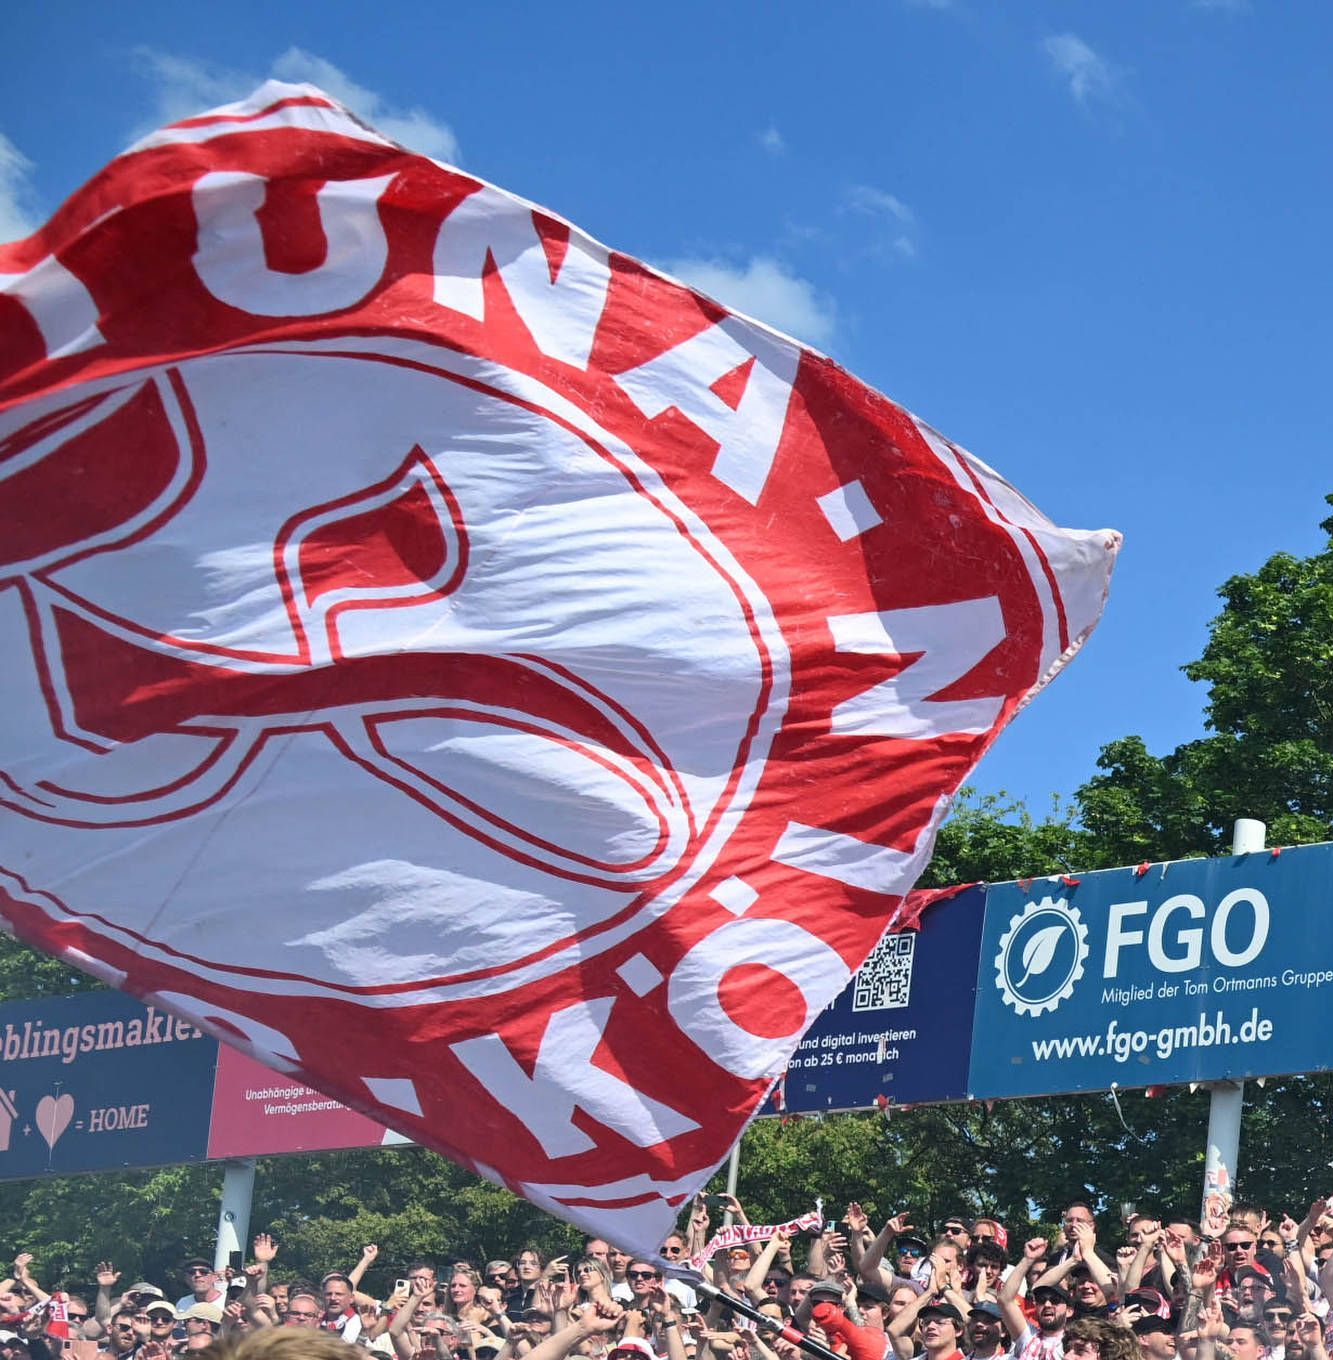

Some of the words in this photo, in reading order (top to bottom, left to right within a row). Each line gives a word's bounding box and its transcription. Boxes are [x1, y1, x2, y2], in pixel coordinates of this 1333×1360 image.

[1103, 887, 1271, 980] FGO
[1101, 982, 1153, 1007] Mitglied
[1157, 981, 1180, 999] der
[1184, 979, 1208, 996] Tom
[1213, 974, 1278, 993] Ortmanns
[1281, 968, 1333, 989] Gruppe
[821, 1032, 856, 1050] digital
[857, 1028, 917, 1044] investieren
[1031, 1007, 1274, 1064] www.fgo-gmbh.de
[804, 1055, 819, 1068] ab
[820, 1053, 834, 1066] 25
[836, 1052, 844, 1065] €
[845, 1047, 899, 1064] monatich
[245, 1085, 305, 1101] Unabhängige
[89, 1104, 150, 1132] HOME
[264, 1099, 352, 1116] Vermögensberatu
